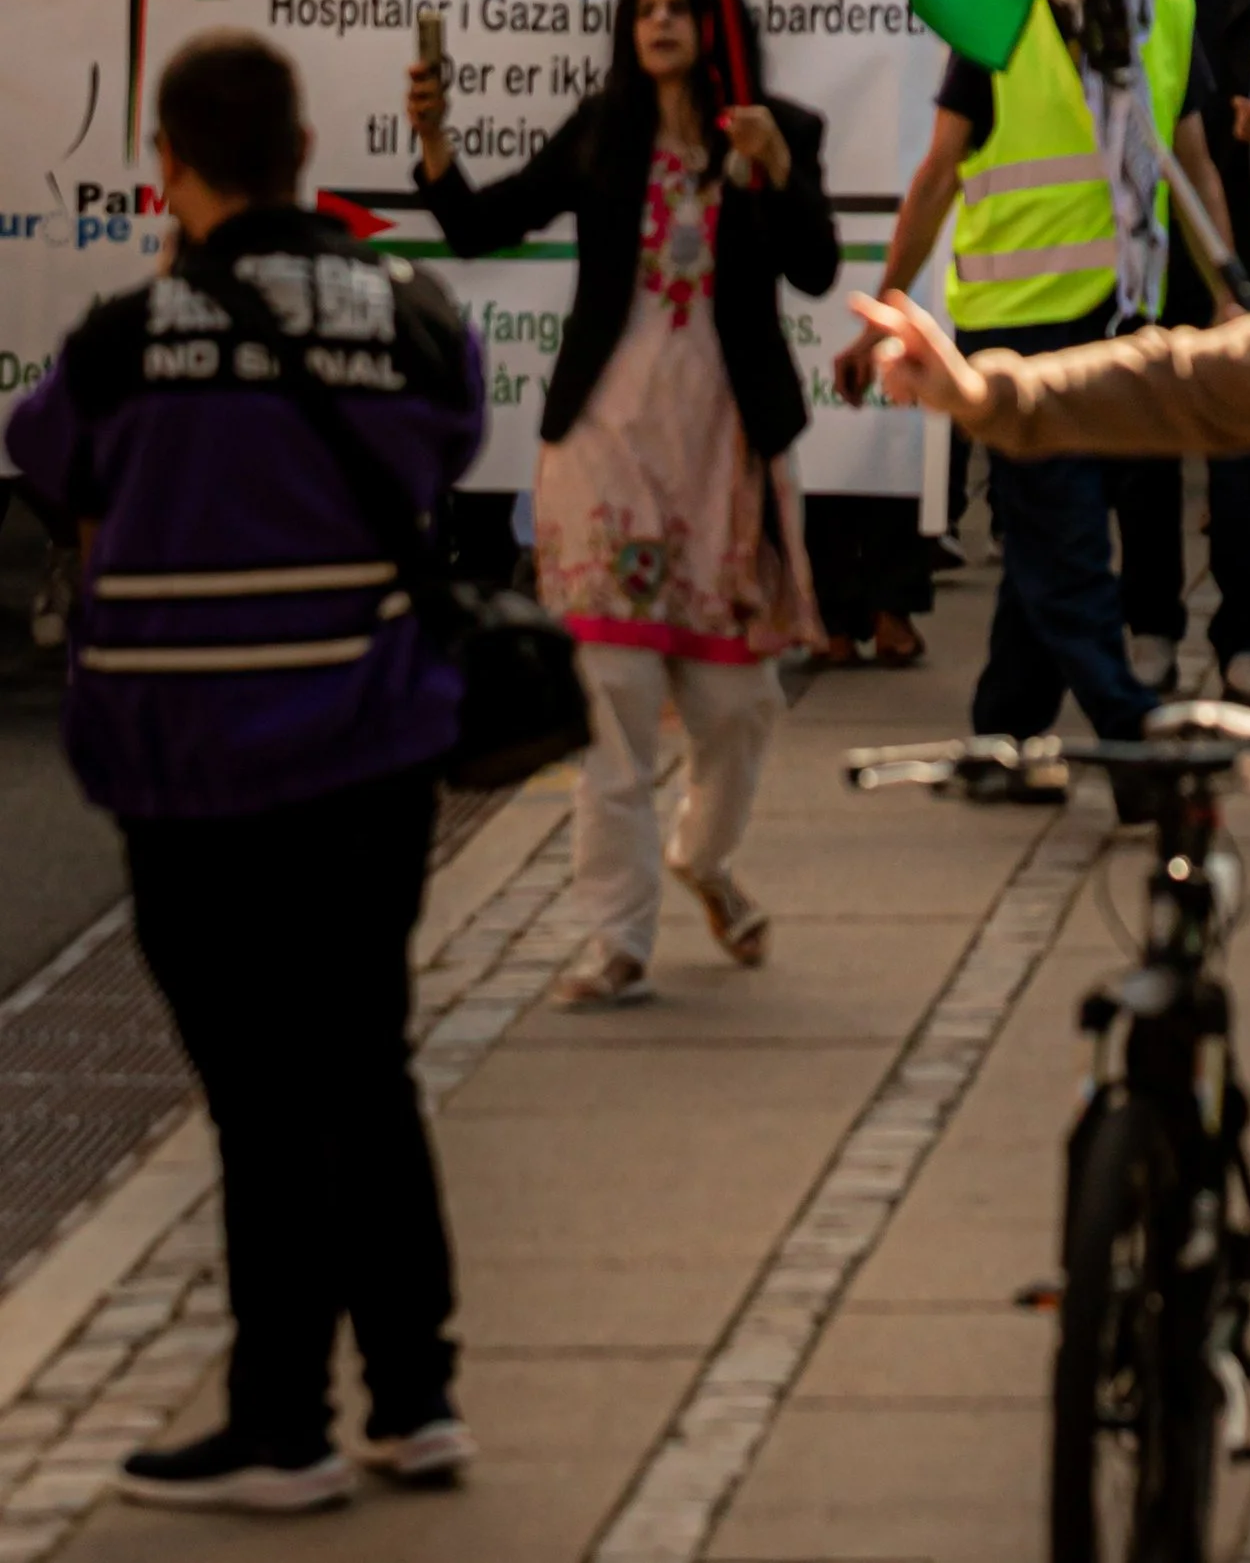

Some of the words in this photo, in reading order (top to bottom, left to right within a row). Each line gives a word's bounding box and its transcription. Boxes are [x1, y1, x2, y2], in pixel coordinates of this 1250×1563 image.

[505, 63, 542, 96] er
[551, 54, 605, 95] ikk
[367, 114, 398, 154] til
